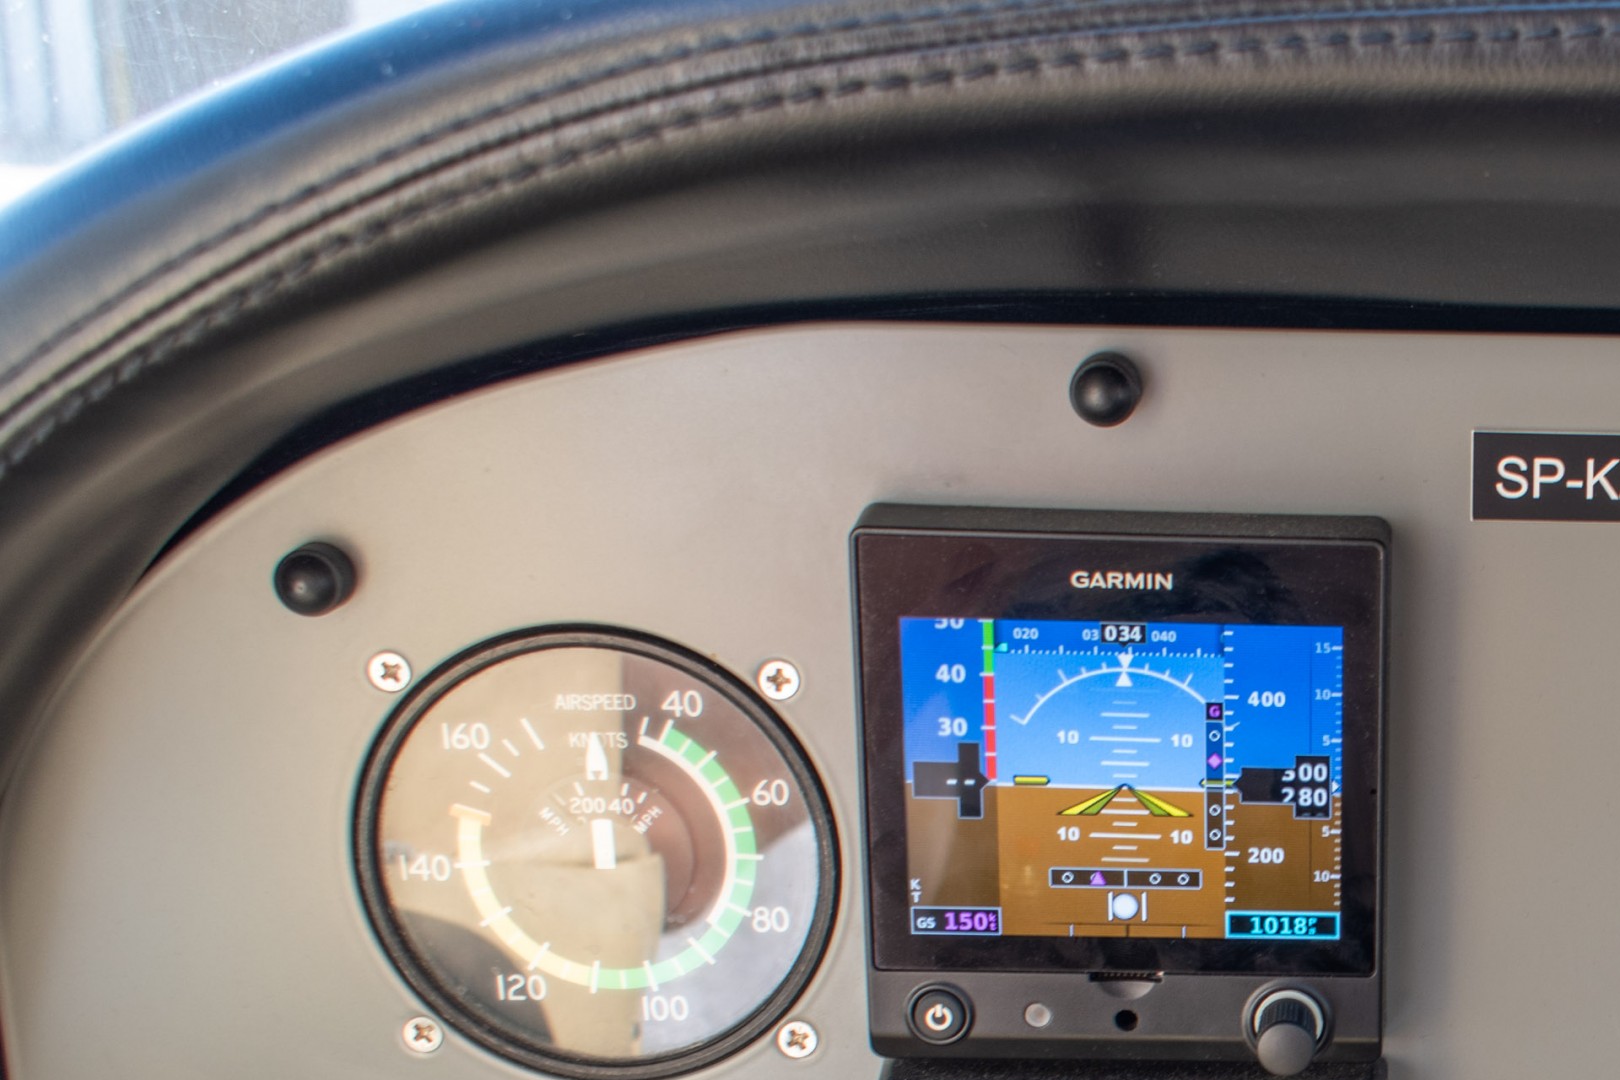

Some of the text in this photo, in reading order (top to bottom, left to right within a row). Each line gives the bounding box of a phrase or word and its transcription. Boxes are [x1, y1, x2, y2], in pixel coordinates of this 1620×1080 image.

[1071, 571, 1173, 590] GARMIN
[1104, 624, 1143, 643] 034
[935, 663, 966, 684] 40
[554, 693, 637, 711] AIRSPEED
[661, 690, 702, 718] 40
[1247, 690, 1287, 709] 400
[441, 723, 490, 749] 160
[937, 717, 968, 737] 30
[751, 780, 790, 806] 60
[1247, 847, 1285, 865] 200
[399, 855, 451, 882] 140
[751, 907, 790, 932] 80
[496, 974, 547, 1001] 120
[641, 995, 689, 1021] 100
